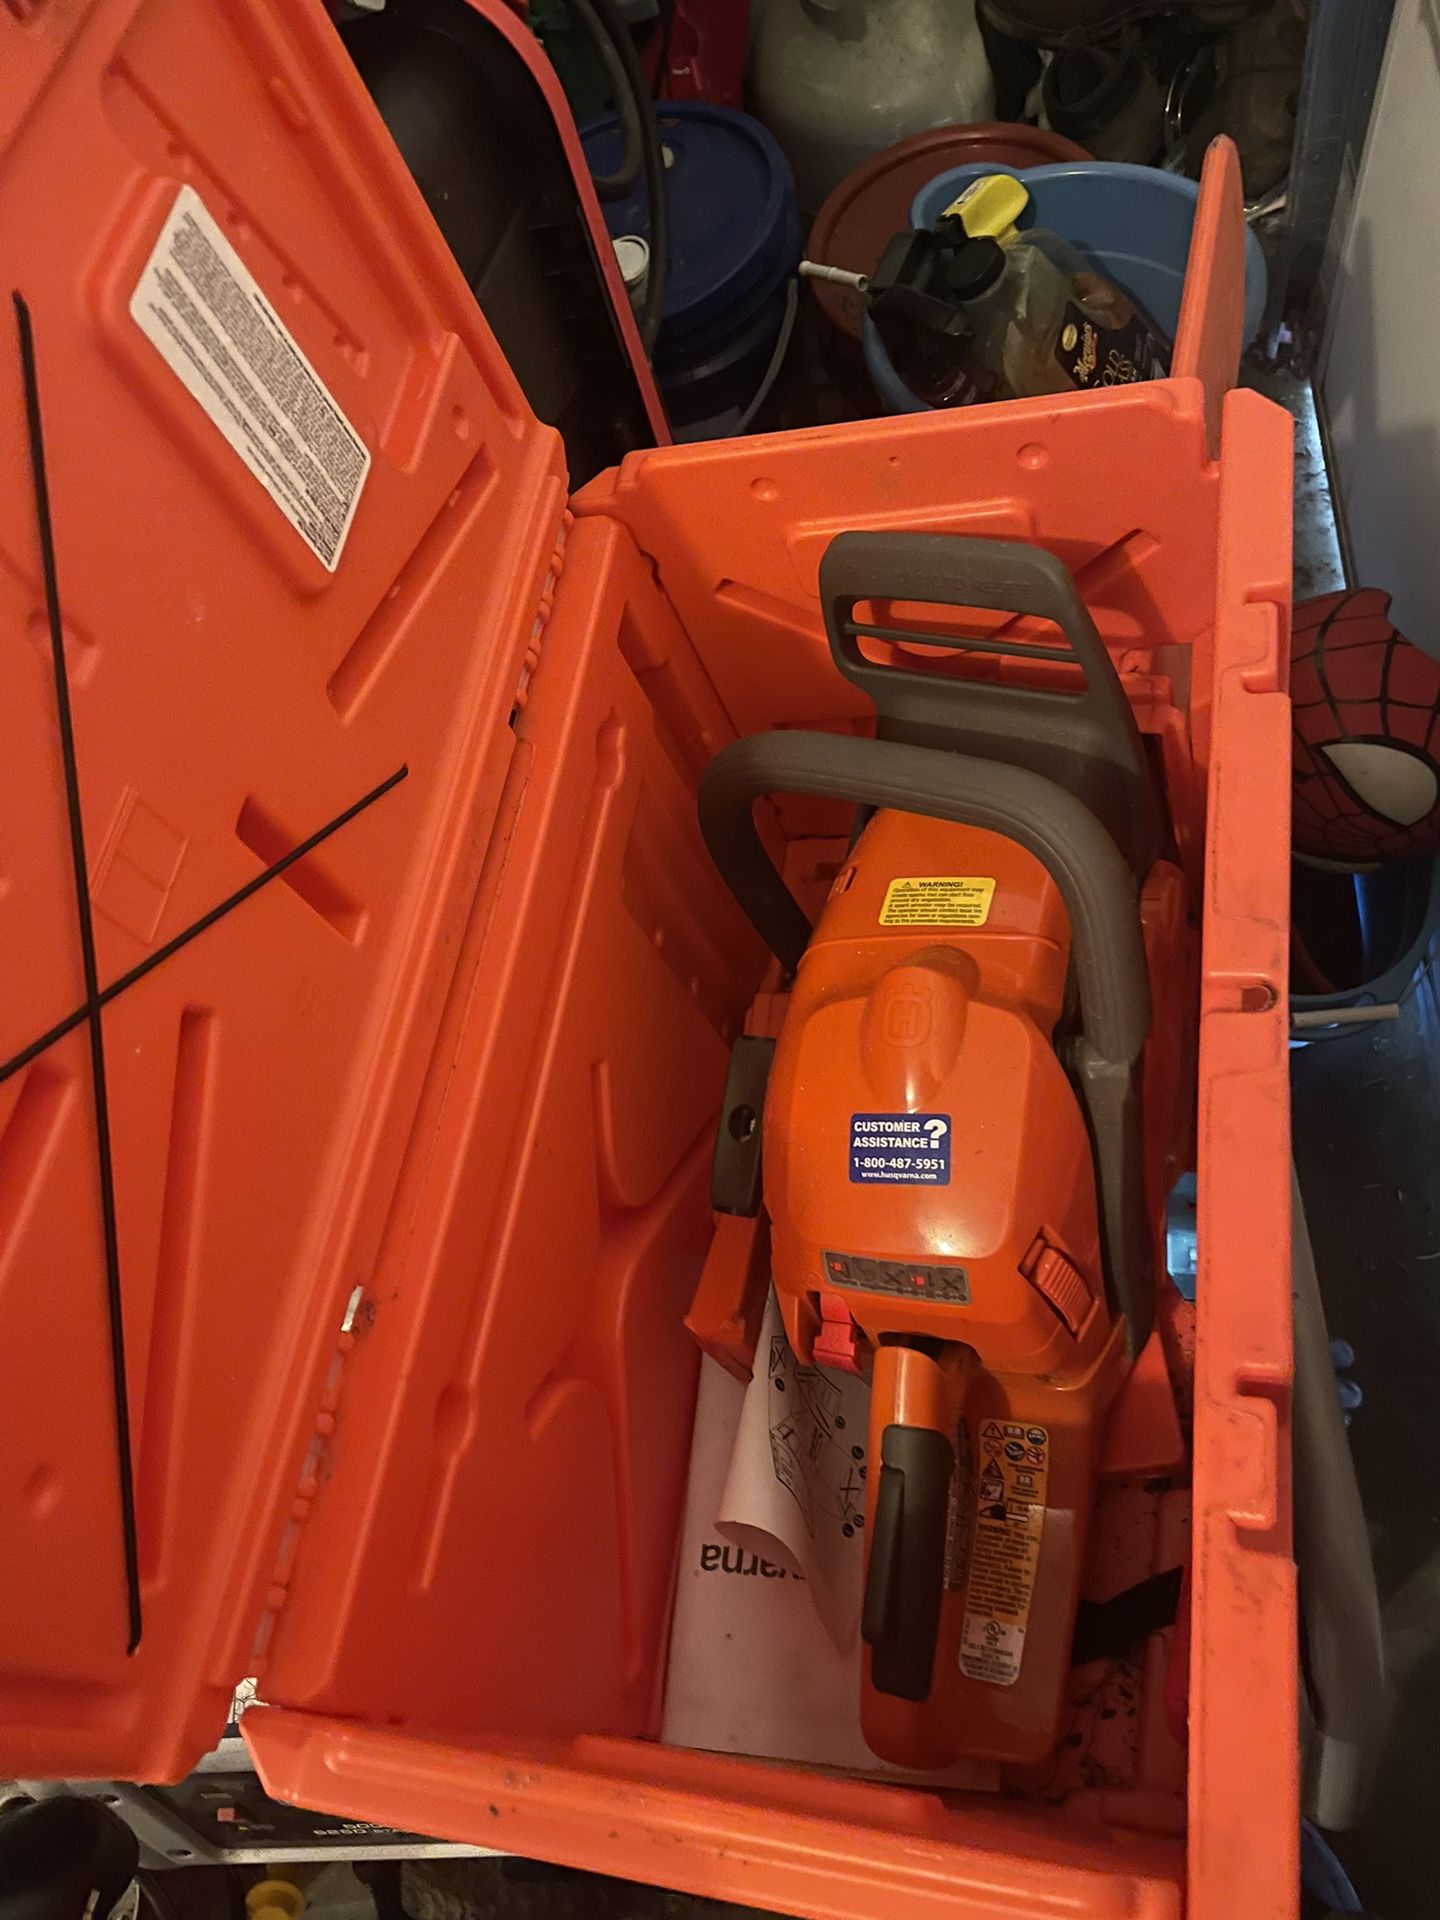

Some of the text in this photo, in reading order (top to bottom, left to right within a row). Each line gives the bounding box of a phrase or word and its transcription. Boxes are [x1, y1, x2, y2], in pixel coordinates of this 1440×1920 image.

[854, 1122, 920, 1132] CUSTOMER
[854, 1137, 928, 1148] ASSISTANCE
[854, 1158, 945, 1169] 1-800-487-5951
[861, 1171, 937, 1180] www.husqvarna.com
